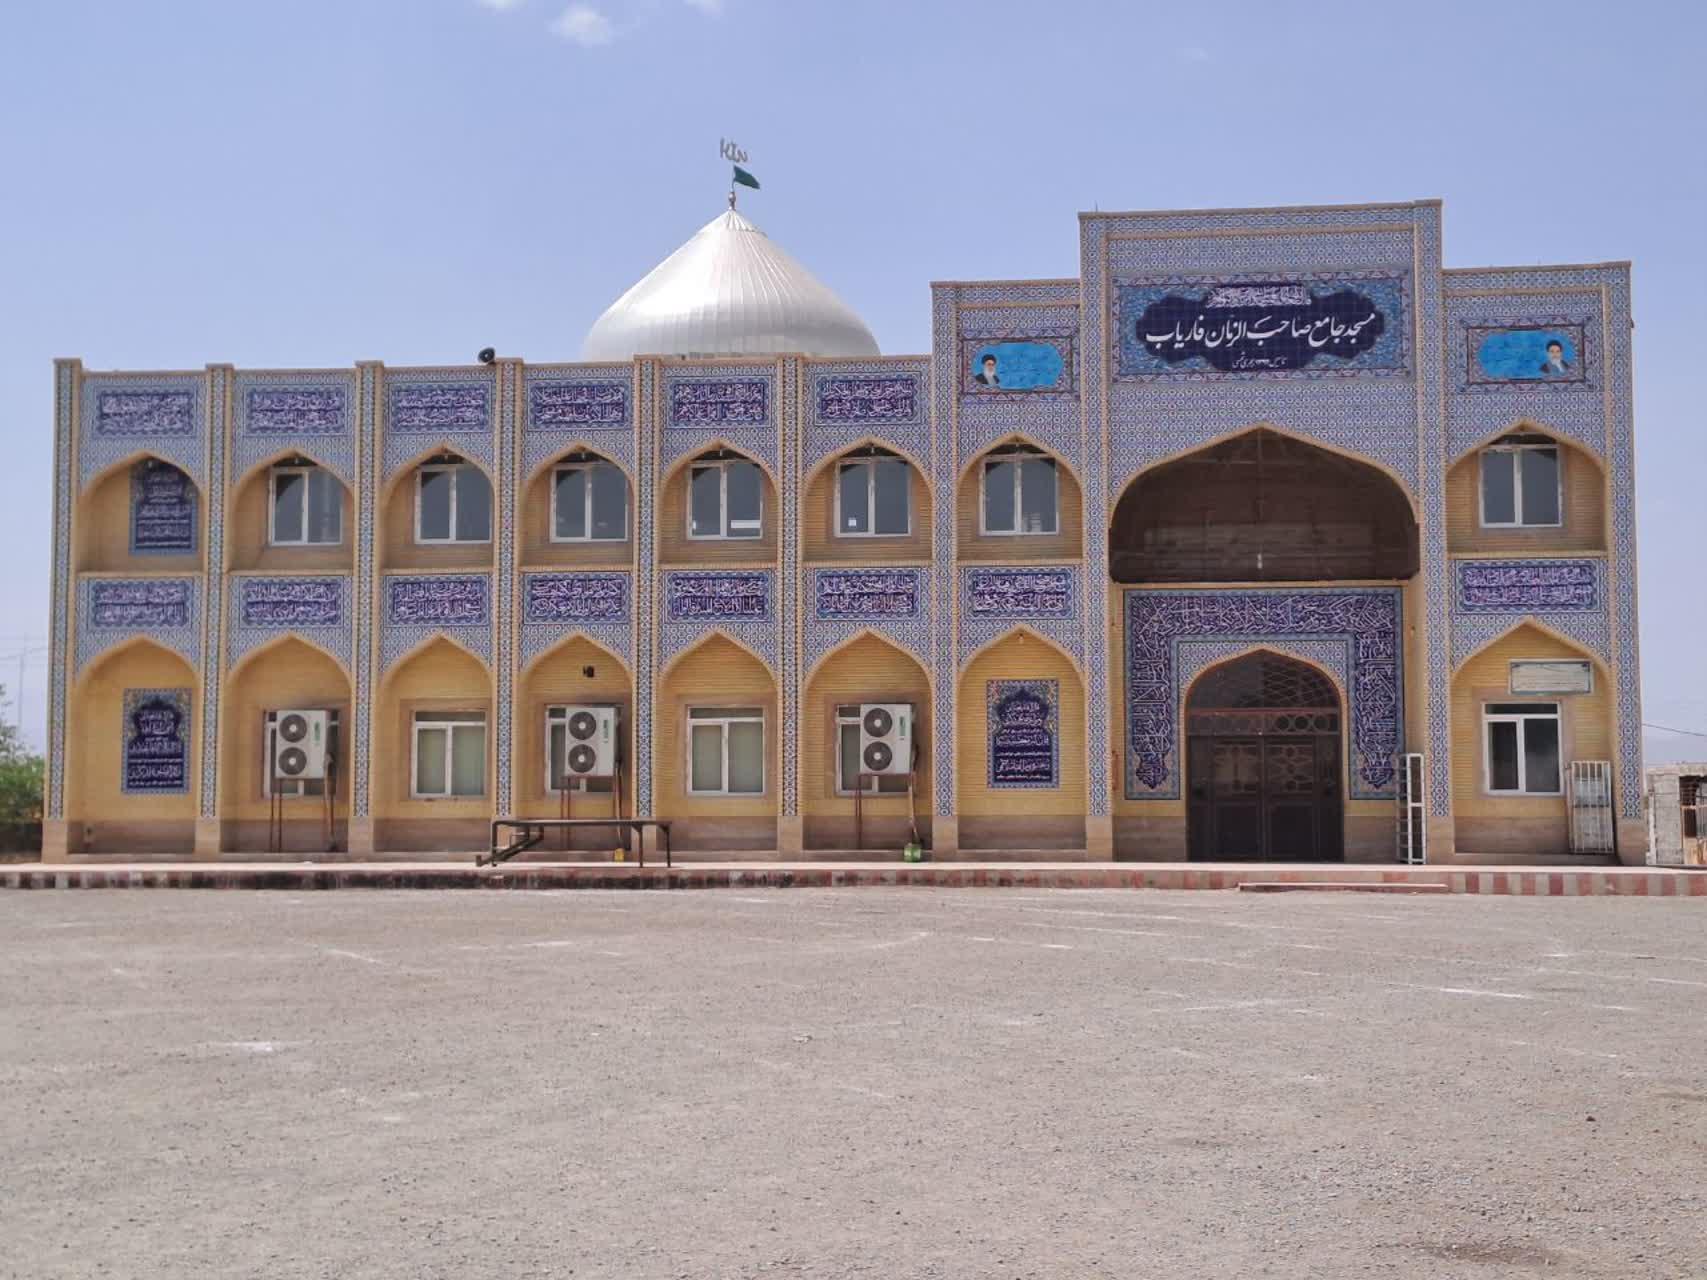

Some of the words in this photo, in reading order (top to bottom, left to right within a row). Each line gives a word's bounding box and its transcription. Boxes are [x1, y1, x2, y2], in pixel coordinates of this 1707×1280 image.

[1145, 314, 1205, 349] فاریاب
[1204, 319, 1248, 348] الزمان
[1246, 315, 1312, 347] صاحب
[1308, 316, 1345, 348] جامع
[1342, 313, 1376, 344] مسجد
